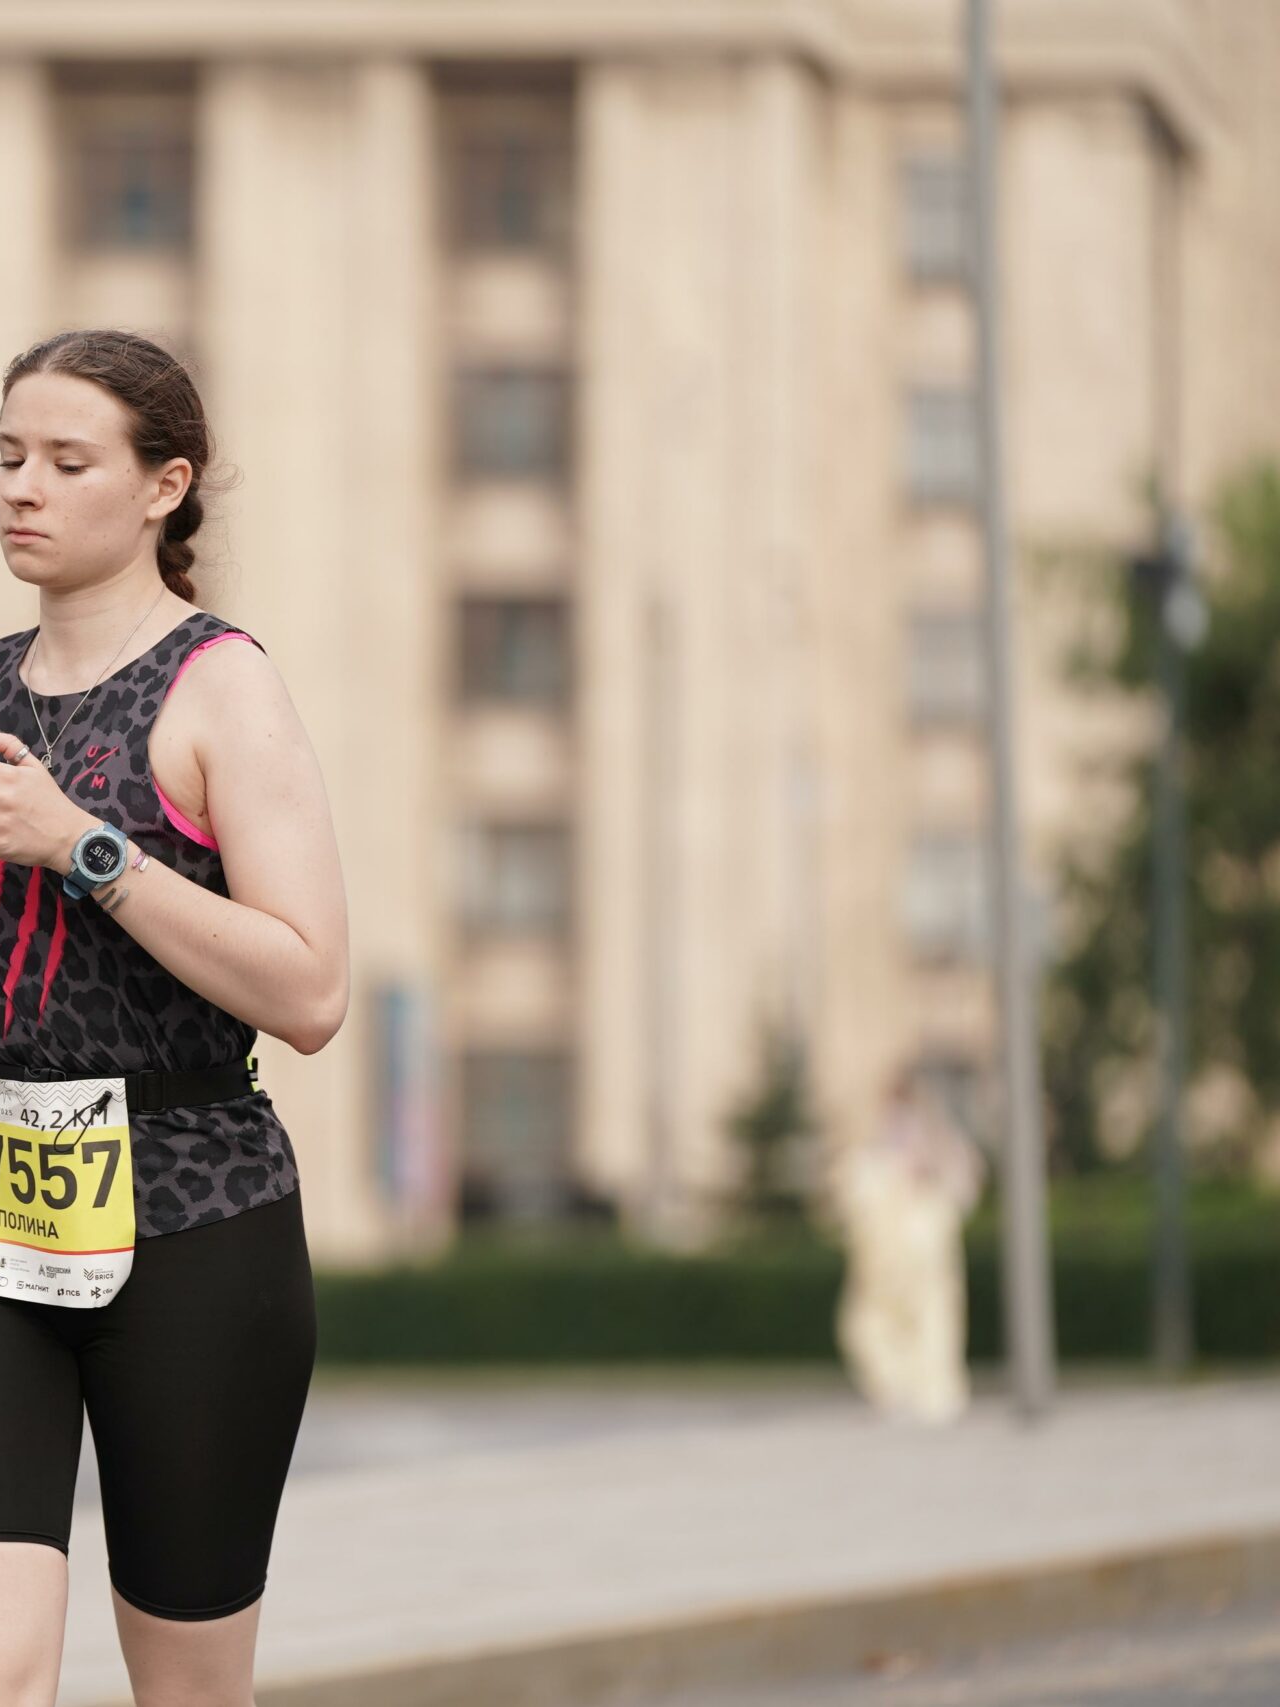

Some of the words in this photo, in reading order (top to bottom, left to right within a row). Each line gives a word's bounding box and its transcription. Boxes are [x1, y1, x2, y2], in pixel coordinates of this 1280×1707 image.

[87, 746, 99, 758] U
[20, 1108, 63, 1131] 42,2
[95, 1272, 114, 1281] BRICS
[25, 1283, 49, 1293] МАГНИТ
[66, 1289, 81, 1297] ПСБ
